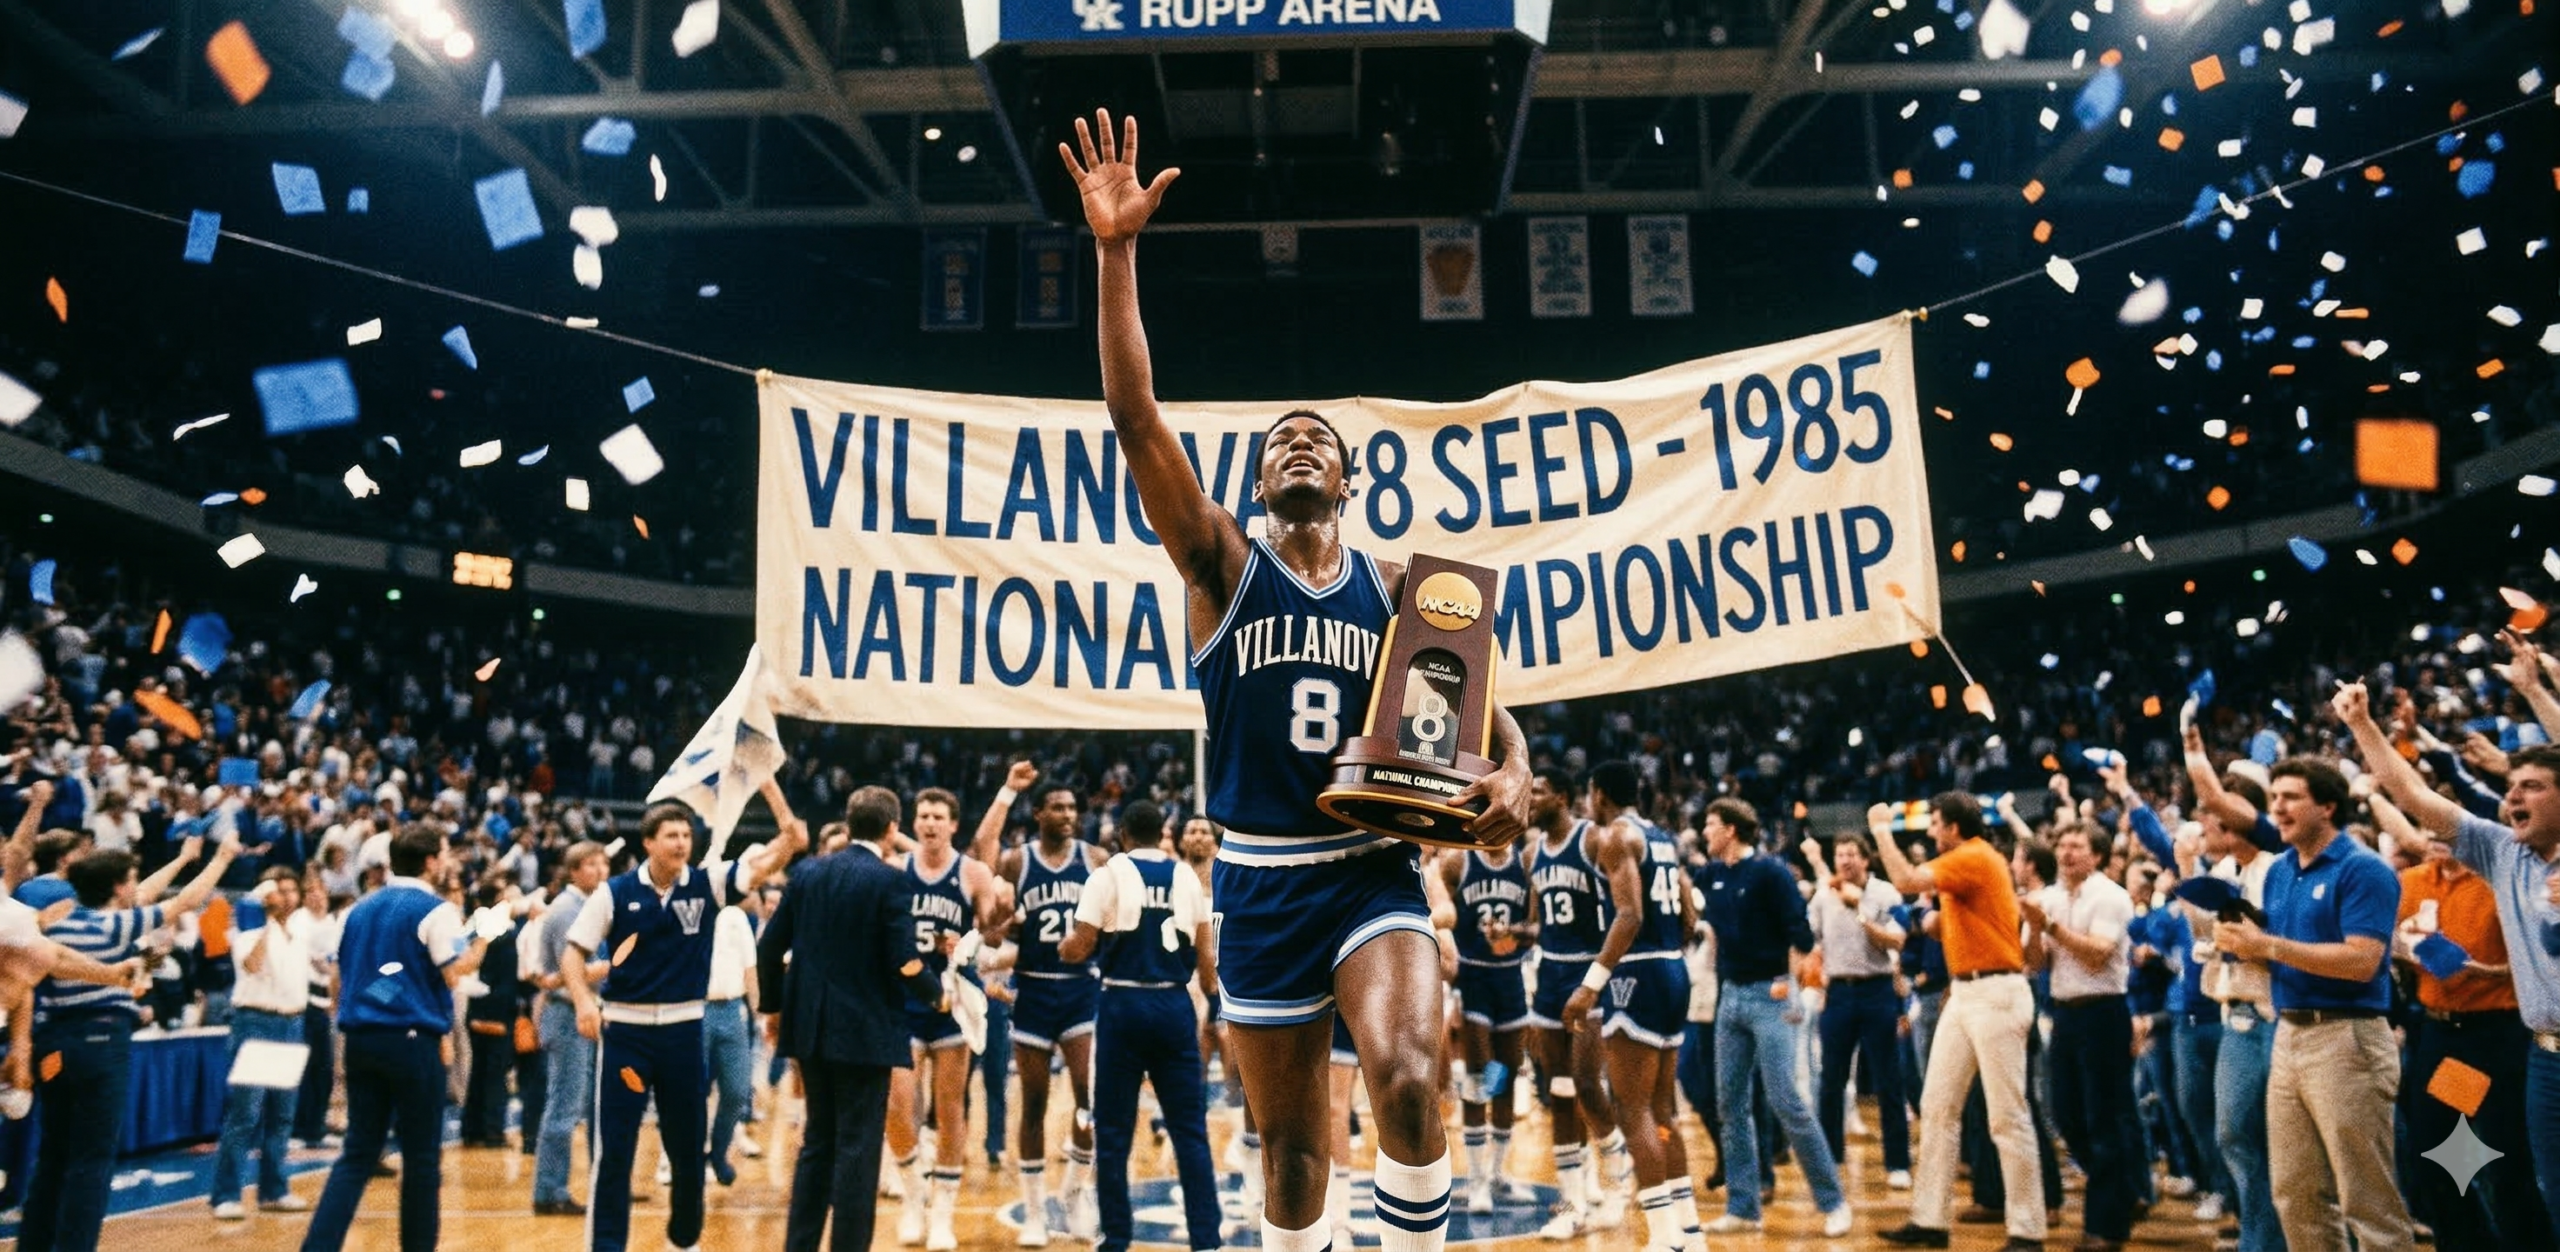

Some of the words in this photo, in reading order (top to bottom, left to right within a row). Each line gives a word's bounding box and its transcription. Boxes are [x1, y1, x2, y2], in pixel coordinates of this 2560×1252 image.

[1140, 0, 1266, 28] RUPP
[1278, 0, 1442, 25] ARENA
[1432, 407, 1632, 534] SEED
[1700, 348, 1893, 491] 1985
[1420, 595, 1480, 621] NCAA
[1494, 504, 1894, 668] MPIONSHIP
[1234, 614, 1380, 680] VILLANOV
[1290, 677, 1342, 754] 8
[1412, 691, 1448, 742] 8
[1039, 908, 1074, 942] 21
[1543, 891, 1575, 925] 13
